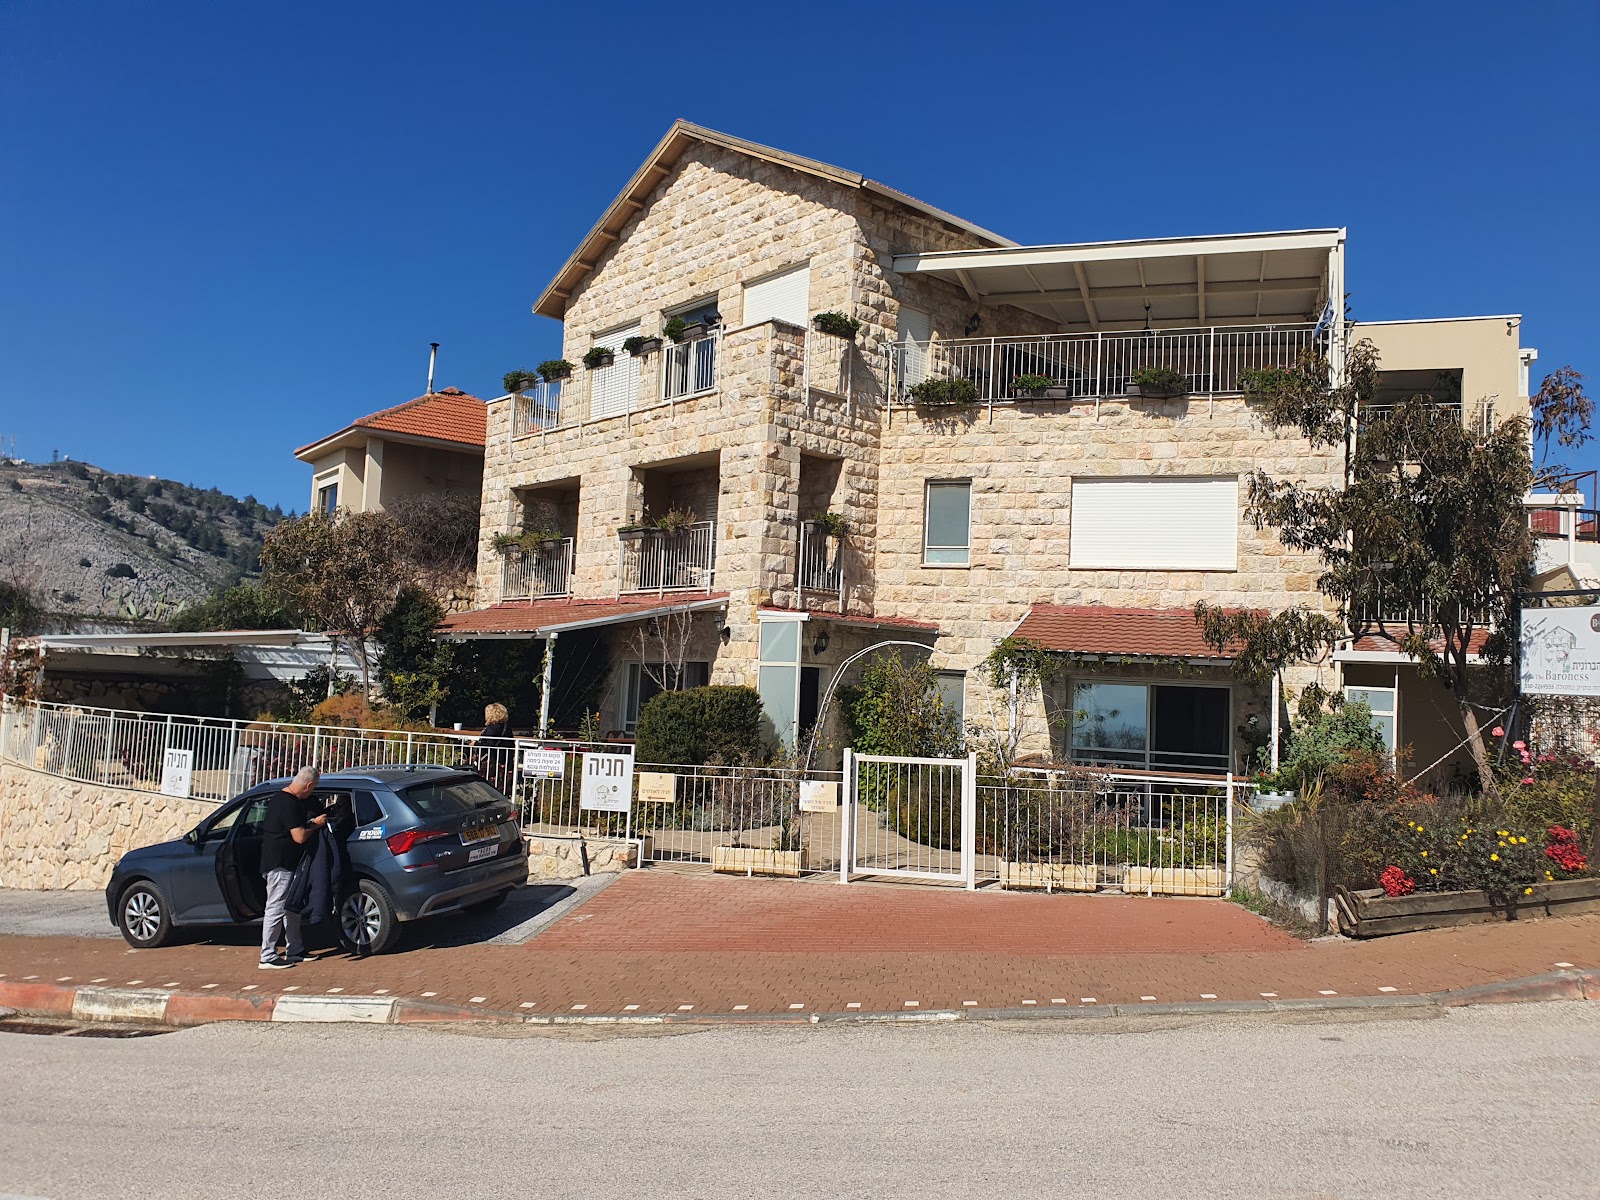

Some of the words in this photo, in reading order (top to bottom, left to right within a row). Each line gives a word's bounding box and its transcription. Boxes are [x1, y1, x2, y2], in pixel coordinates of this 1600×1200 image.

[1545, 669, 1589, 681] Baroness
[167, 752, 187, 769] חניה
[589, 758, 624, 776] חניה
